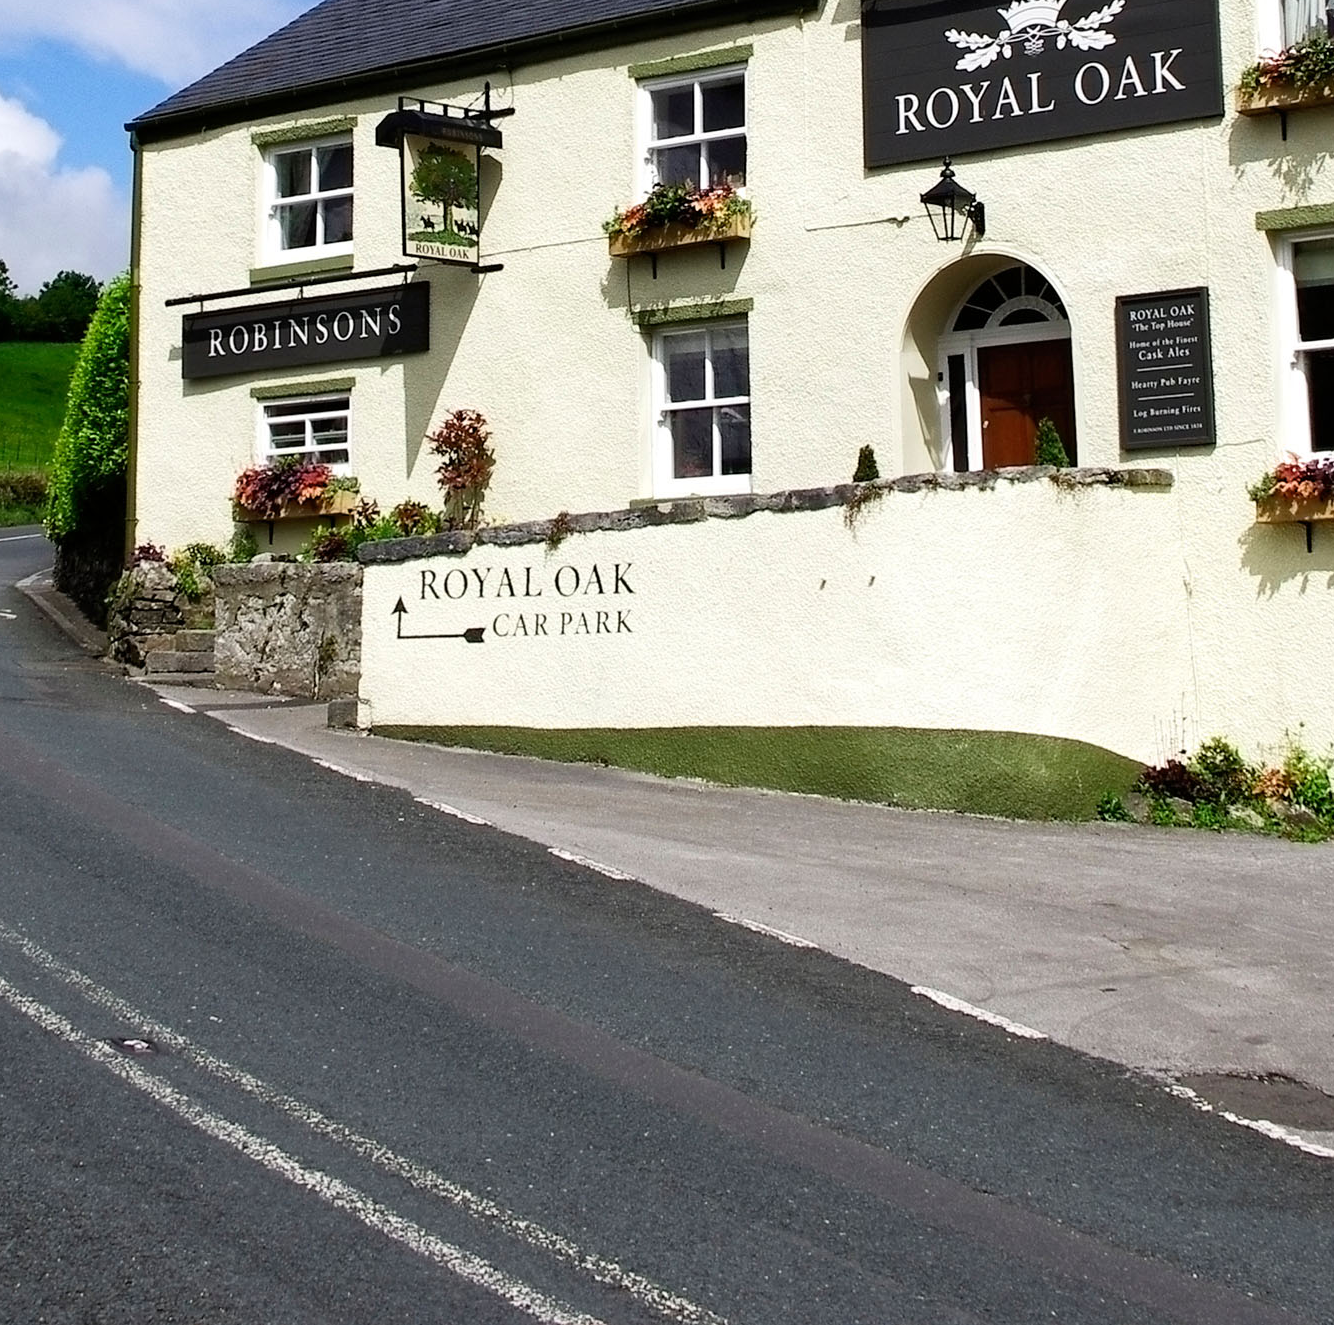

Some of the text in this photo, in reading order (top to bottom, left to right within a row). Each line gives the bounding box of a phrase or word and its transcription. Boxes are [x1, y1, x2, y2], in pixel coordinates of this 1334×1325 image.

[895, 48, 1186, 136] ROYAL OAK
[415, 243, 469, 260] ROYAL OAK
[1129, 304, 1195, 321] ROYAL OAK
[208, 304, 402, 358] ROBINSONS
[1151, 321, 1166, 331] Top
[1129, 341, 1150, 349] Home
[1152, 338, 1160, 346] of
[1176, 336, 1198, 344] Finest
[1138, 347, 1190, 361] Cask Ales
[1131, 376, 1200, 389] Hearty Pub Fayre
[1133, 405, 1201, 419] Log Burning Fires
[1174, 423, 1190, 431] SINCE
[420, 563, 635, 600] ROYAL OAK
[492, 609, 633, 637] CAR PARK
